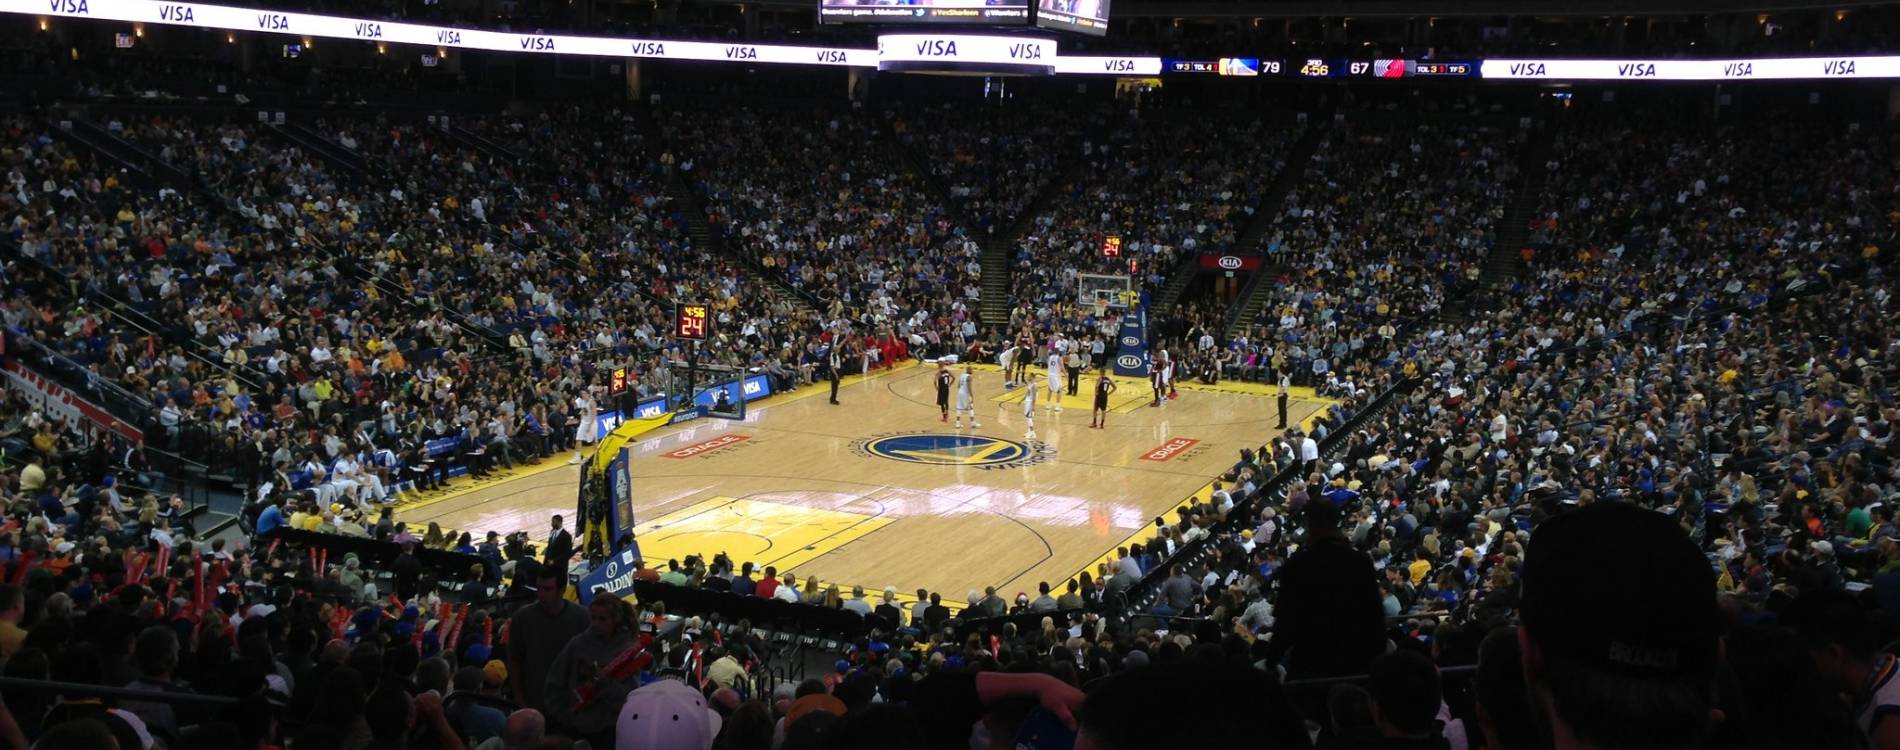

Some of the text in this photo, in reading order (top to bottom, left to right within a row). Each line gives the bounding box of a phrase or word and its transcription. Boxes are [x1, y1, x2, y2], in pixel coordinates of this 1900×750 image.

[50, 0, 88, 14] VISA
[160, 5, 193, 22] VISA
[258, 14, 288, 30] VISA
[356, 23, 381, 38] VISA
[437, 30, 461, 45] VISA
[521, 37, 554, 51] VISA
[632, 42, 664, 56] VISA
[917, 40, 957, 57] VISA
[1010, 43, 1040, 59] VISA
[726, 46, 756, 60] VISA
[817, 50, 846, 63] VISA
[1104, 60, 1134, 72] VISA
[1206, 63, 1212, 71] 4
[1262, 61, 1280, 73] 79
[1300, 65, 1329, 76] 4:56
[1350, 62, 1369, 74] 67
[1430, 65, 1437, 73] 3
[1458, 65, 1465, 73] 5
[1510, 62, 1546, 77] VISA
[1619, 63, 1655, 77] VISA
[1724, 62, 1752, 77] VISA
[1825, 60, 1855, 76] VISA
[1104, 243, 1118, 256] 24
[1220, 257, 1239, 267] KIA
[685, 306, 705, 318] 4:56
[682, 316, 703, 336] 24
[1120, 357, 1139, 367] KIA
[743, 380, 761, 395] VISA
[641, 405, 661, 418] VISA
[672, 436, 740, 457] ORACLE
[1148, 439, 1192, 460] ORACLE
[590, 567, 638, 594] ALDIN
